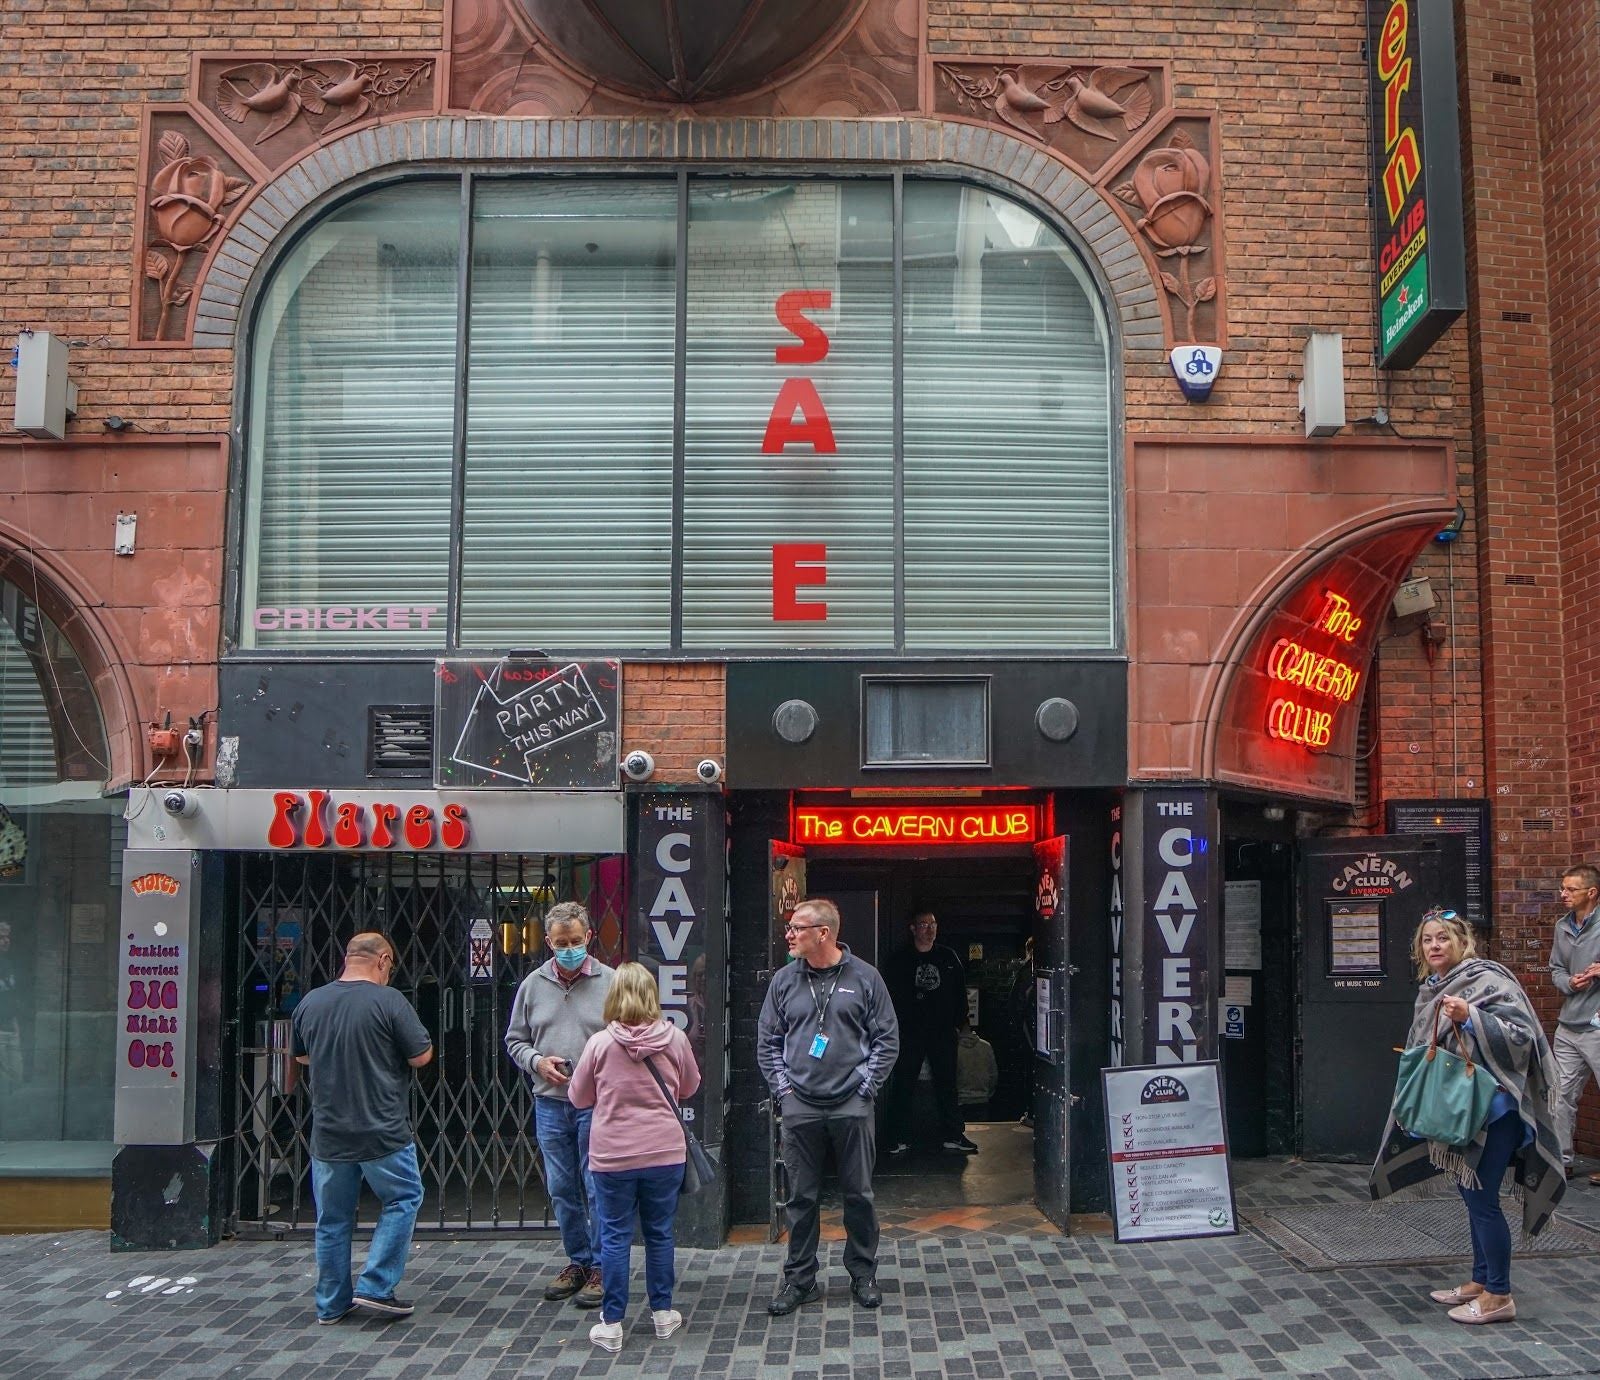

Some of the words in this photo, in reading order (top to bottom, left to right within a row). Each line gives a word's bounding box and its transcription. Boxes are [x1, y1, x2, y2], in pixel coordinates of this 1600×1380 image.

[1377, 0, 1421, 227] ern
[1380, 199, 1425, 273] CLUB
[1382, 234, 1424, 290] LIVERPOOL
[1386, 293, 1423, 344] Heineken
[254, 607, 437, 630] CRICKET
[1315, 590, 1361, 641] The
[1268, 638, 1360, 701] CAVERN
[496, 675, 581, 733] PARTY
[510, 723, 551, 750] THIS
[553, 703, 590, 730] WAY
[1269, 698, 1332, 746] CLUB
[268, 790, 469, 849] Flares
[655, 807, 692, 820] THE
[799, 815, 843, 838] The
[853, 815, 954, 838] CAVERN
[961, 813, 1029, 838] CLUB
[1111, 806, 1121, 821] THE
[1157, 802, 1193, 816] THE
[1332, 858, 1413, 891] CAVERN
[1354, 876, 1390, 887] CLUB
[649, 833, 696, 1031] CAVE
[127, 981, 178, 1009] BIG
[128, 1039, 174, 1068] Out
[1144, 1078, 1185, 1098] CAVERN
